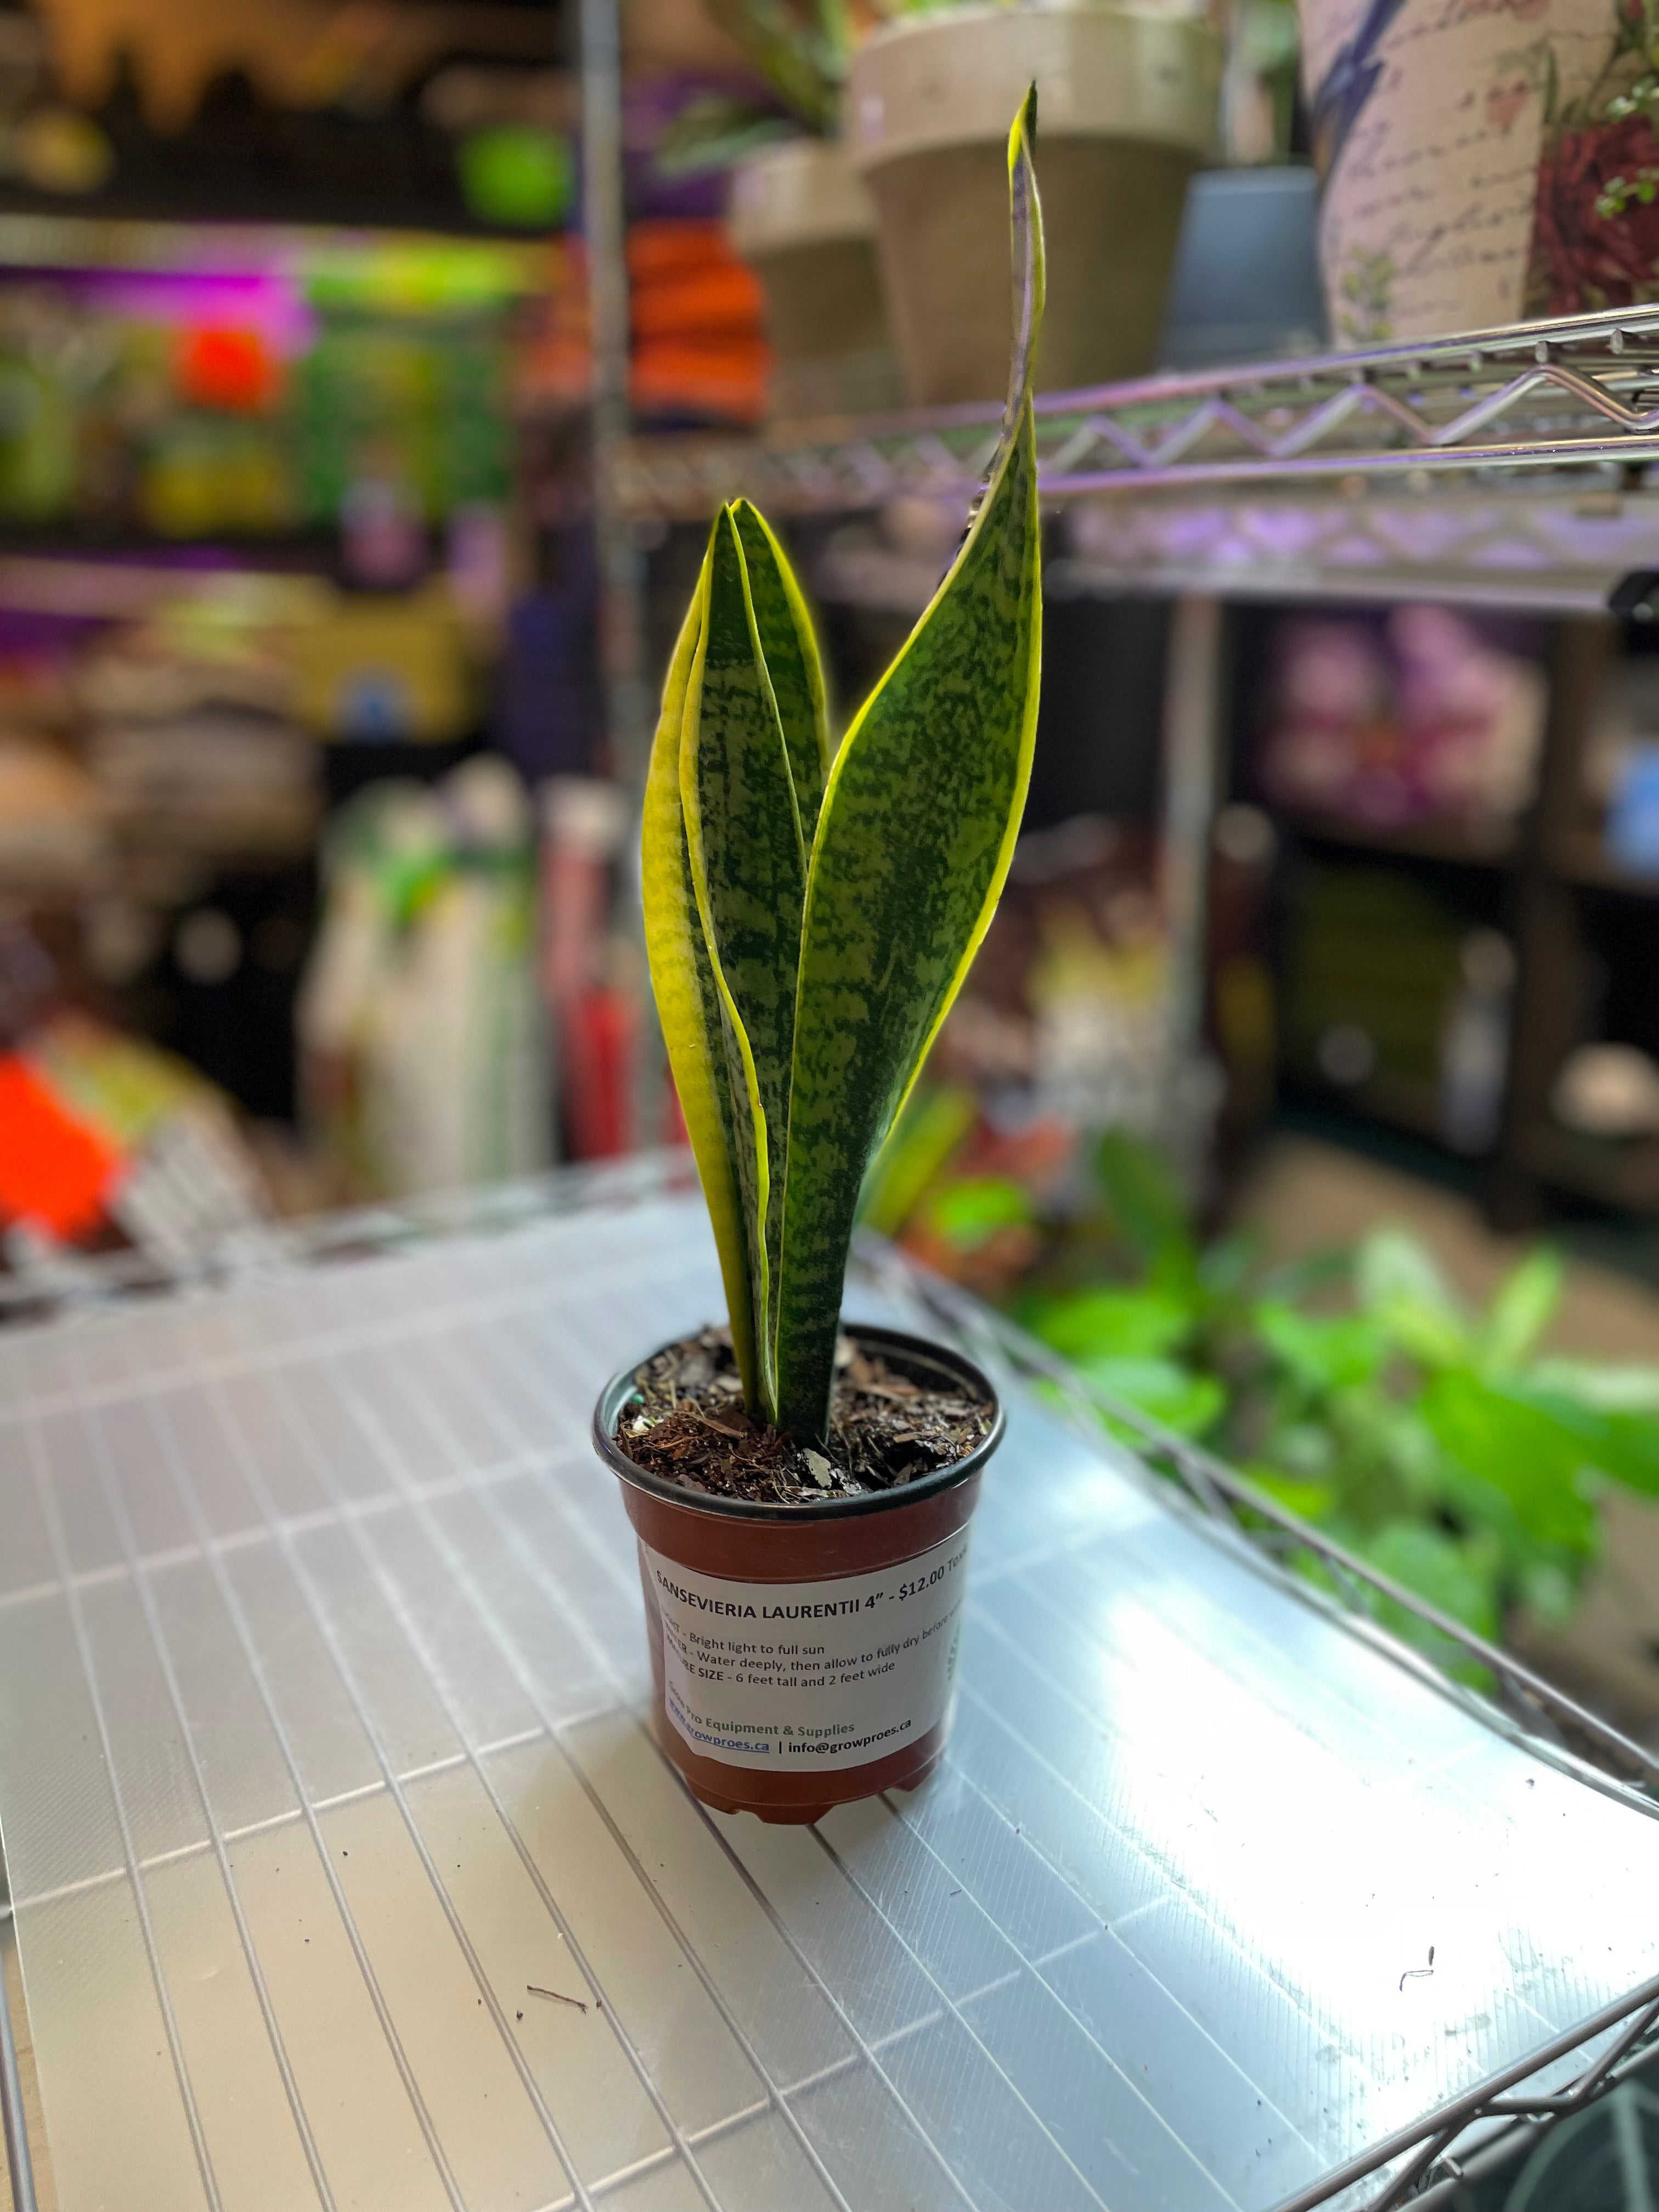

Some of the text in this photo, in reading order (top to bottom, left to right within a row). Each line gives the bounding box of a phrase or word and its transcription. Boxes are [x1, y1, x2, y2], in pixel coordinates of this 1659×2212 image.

[657, 1570, 756, 1618] SANSEVIERIA
[763, 1599, 860, 1619] LAURENTII
[899, 1566, 944, 1601] $12.00
[690, 1632, 725, 1650] Bright
[729, 1641, 757, 1654] light
[760, 1645, 774, 1654] to
[778, 1645, 798, 1655] full
[802, 1646, 825, 1655] sun
[697, 1651, 735, 1667] Water
[740, 1658, 786, 1672] deeply,
[791, 1661, 820, 1671] then
[824, 1656, 857, 1669] allow
[861, 1653, 873, 1663] to
[877, 1644, 900, 1659] fully
[903, 1634, 919, 1649] dry
[922, 1615, 948, 1640] before
[698, 1667, 724, 1681] SIZE
[736, 1673, 743, 1683] 6
[748, 1674, 773, 1685] feet
[777, 1677, 797, 1686] tall
[801, 1677, 825, 1687] and
[829, 1675, 836, 1685] 2
[840, 1670, 865, 1683] feet
[868, 1662, 895, 1677] wide
[706, 1718, 779, 1735] Equipment
[783, 1725, 794, 1736] &
[798, 1724, 855, 1739] Supplies
[788, 1719, 911, 1754] info@growproes.ca
